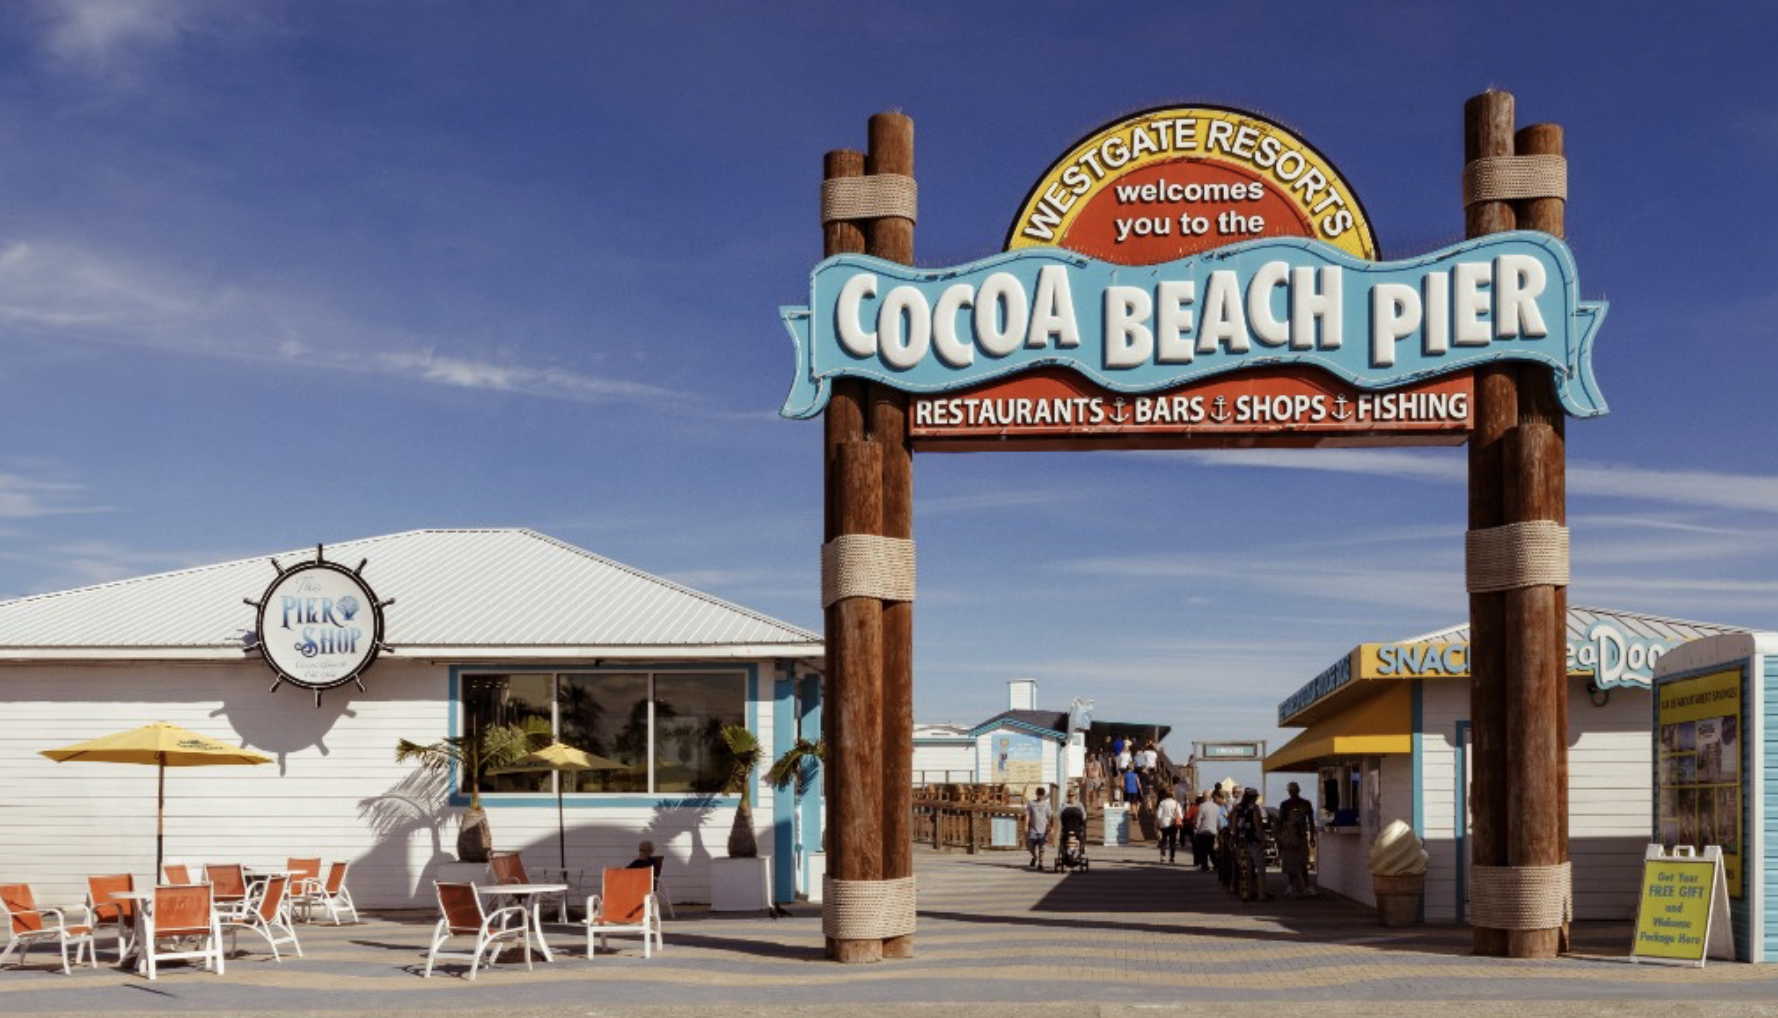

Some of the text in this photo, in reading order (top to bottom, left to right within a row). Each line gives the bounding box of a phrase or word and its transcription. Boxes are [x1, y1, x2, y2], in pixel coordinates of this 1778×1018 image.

[1023, 118, 1354, 242] WESTGATE RESORTS
[1115, 179, 1265, 203] welcomes
[1115, 211, 1265, 242] you to the
[836, 253, 1548, 369] COCOA BEACH PIER
[916, 392, 1468, 425] RESTAURANTS BARS SHOPS FISHING
[280, 595, 344, 631] PIER
[294, 626, 362, 658] SHOP
[1376, 643, 1471, 676] SNAC
[1649, 885, 1704, 898] FREE GIFT
[1658, 871, 1698, 883] Get Your
[1653, 917, 1692, 929] Welcome
[1665, 903, 1683, 913] and
[1639, 931, 1701, 945] Package Here
